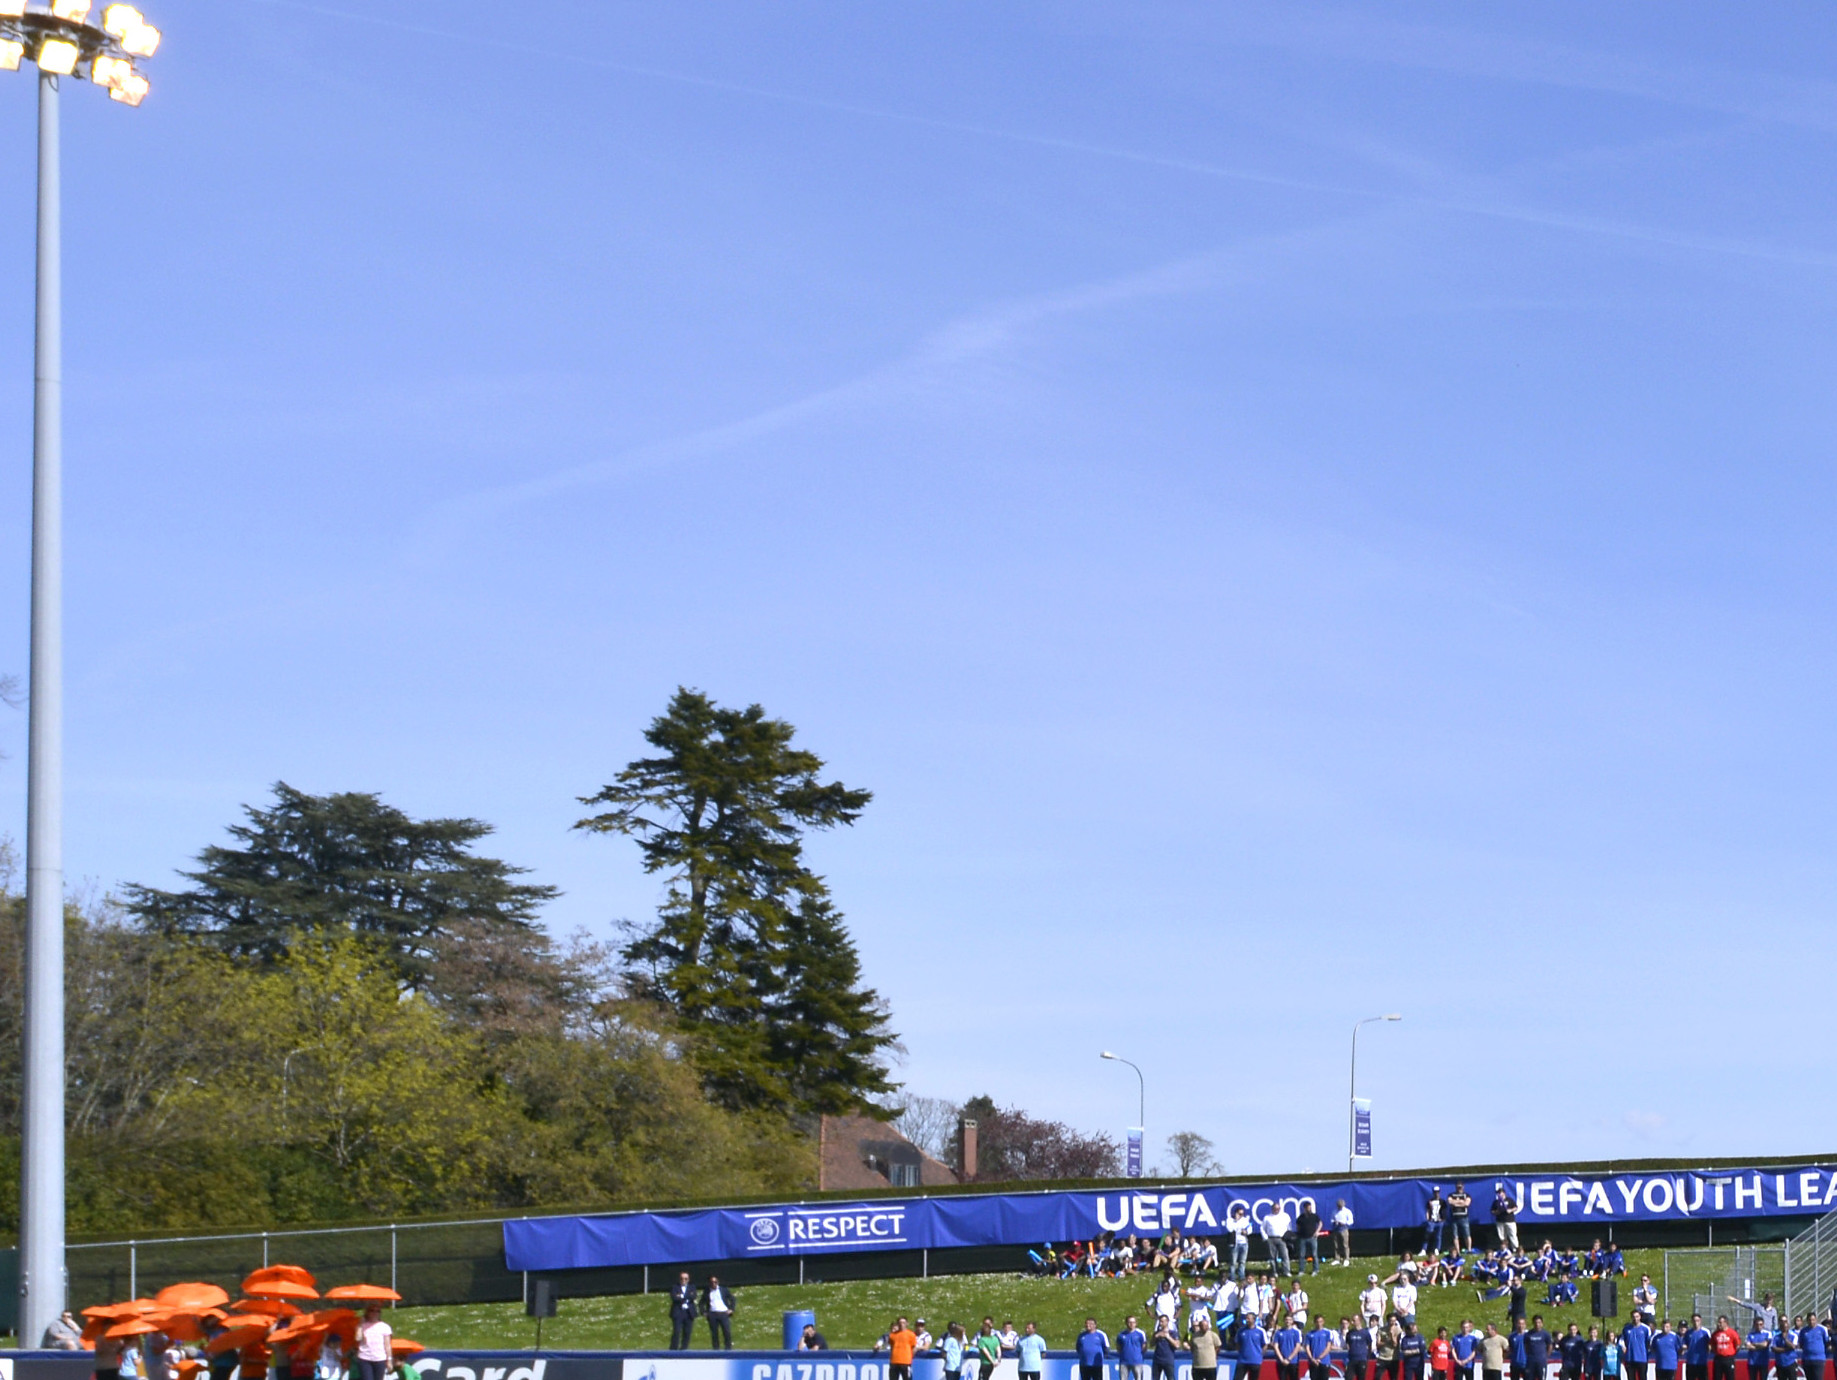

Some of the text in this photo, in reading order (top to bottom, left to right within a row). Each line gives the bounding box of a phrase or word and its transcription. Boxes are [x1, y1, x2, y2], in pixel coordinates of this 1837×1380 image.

[1495, 1180, 1615, 1215] UEFA
[1613, 1174, 1763, 1213] YOUTH
[789, 1214, 906, 1240] RESPECT
